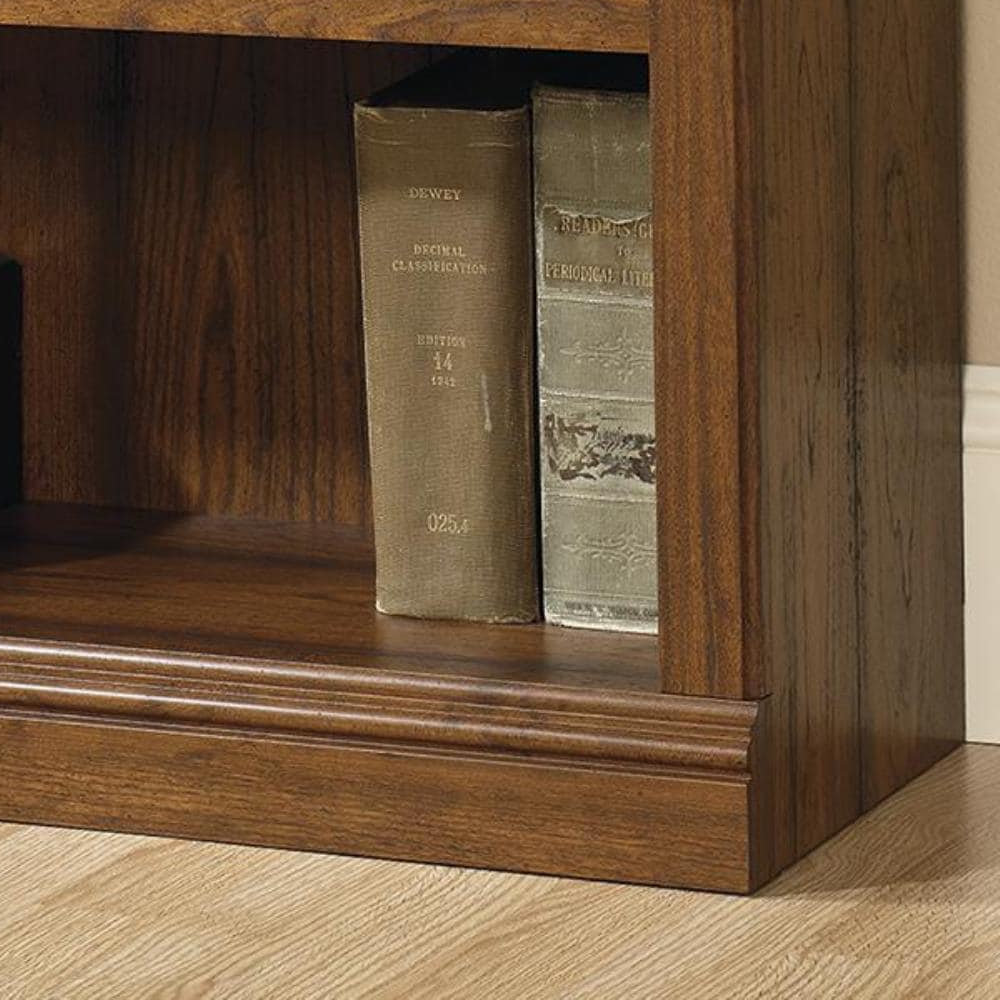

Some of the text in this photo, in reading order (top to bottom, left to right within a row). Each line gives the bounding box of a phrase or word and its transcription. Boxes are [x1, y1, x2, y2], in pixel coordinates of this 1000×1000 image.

[409, 187, 462, 200] DEWEY
[414, 244, 466, 256] DECIMAL
[392, 260, 487, 274] CLASSIFICATION
[545, 263, 616, 284] PERIODICAL
[417, 334, 466, 348] EDITION
[433, 351, 453, 370] 14
